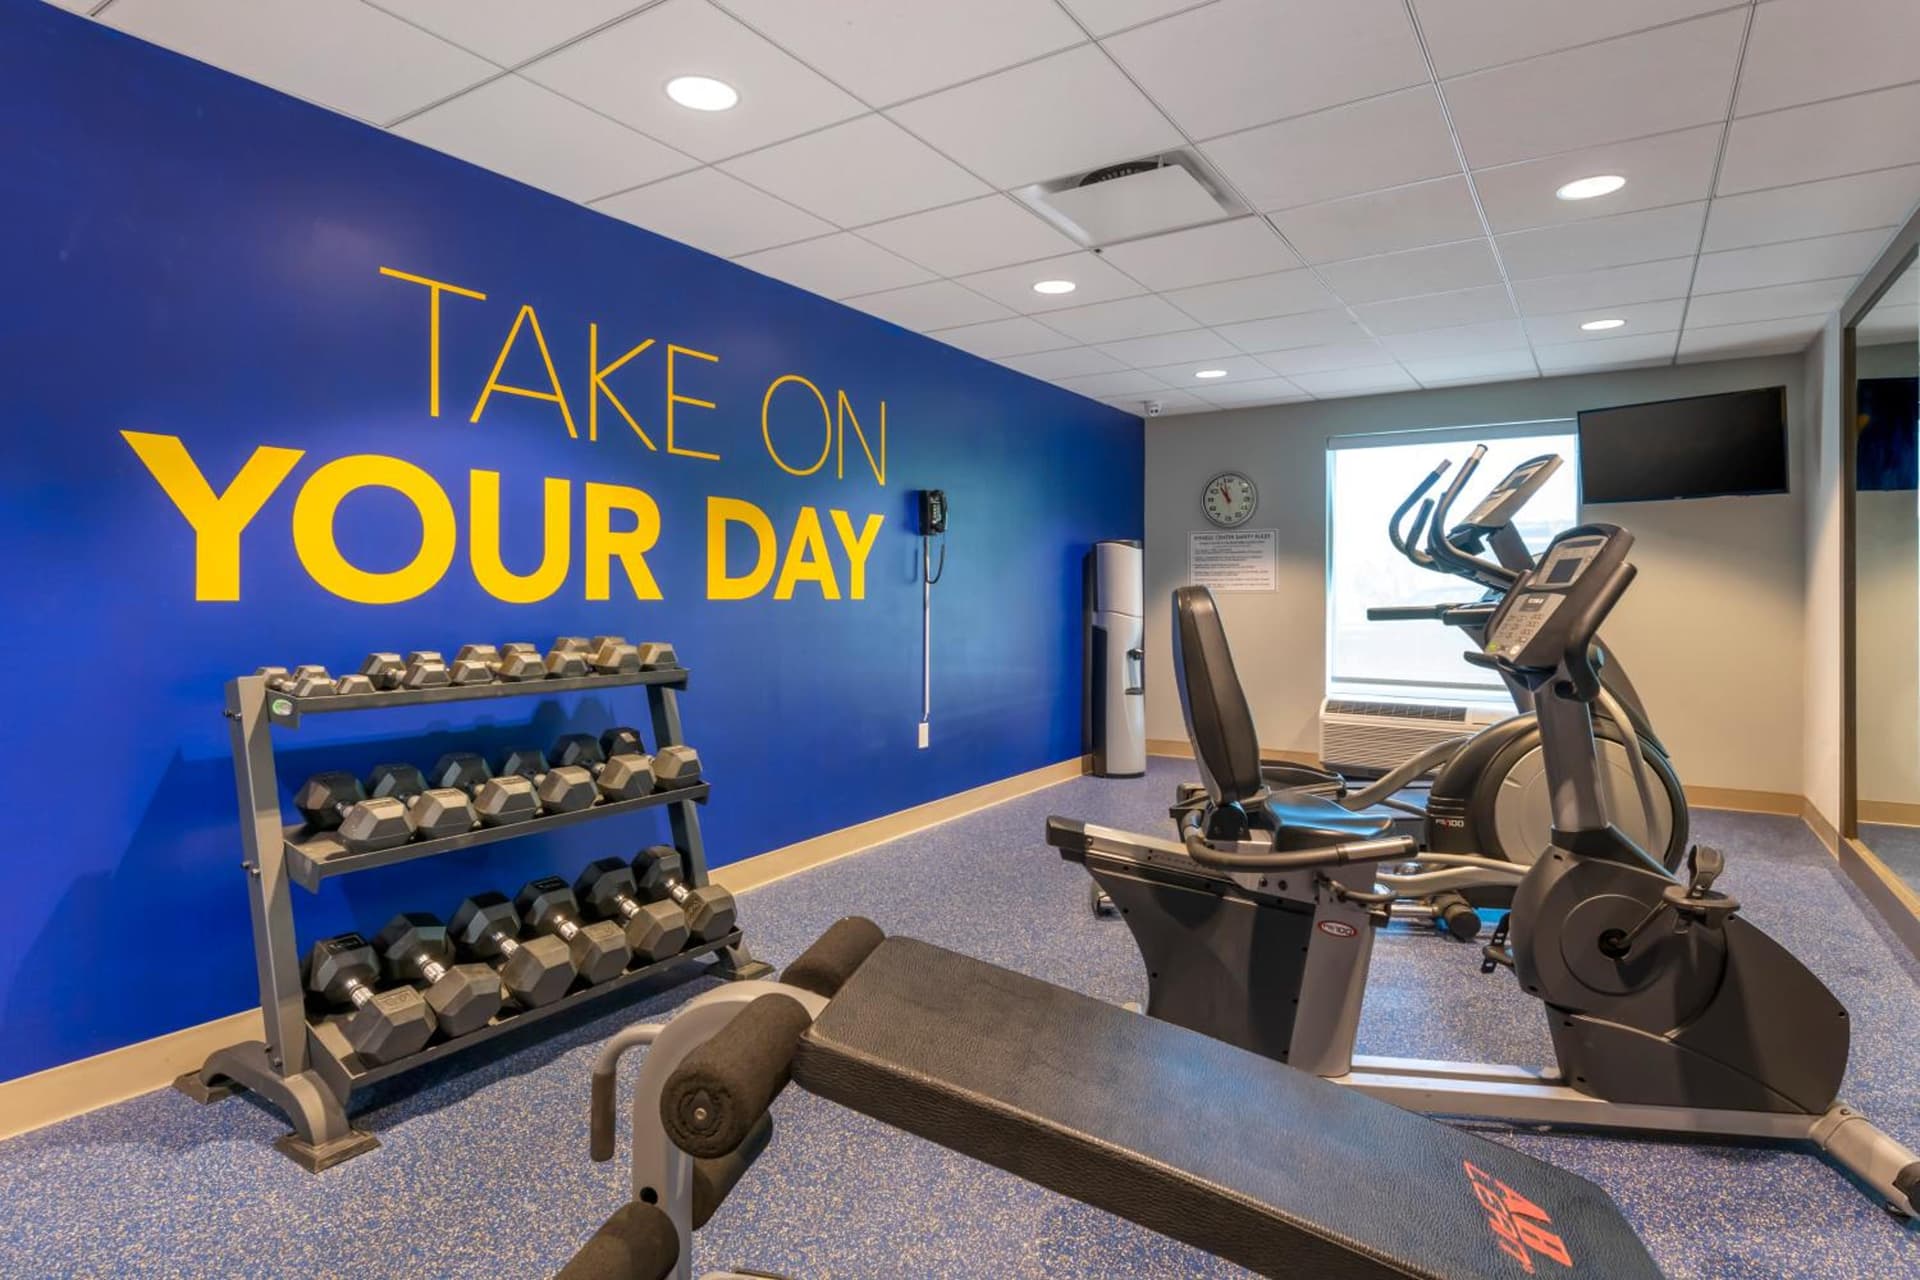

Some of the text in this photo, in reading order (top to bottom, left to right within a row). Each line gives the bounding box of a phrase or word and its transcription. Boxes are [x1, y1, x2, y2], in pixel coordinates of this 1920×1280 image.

[379, 266, 887, 486] TAKE ON
[120, 430, 885, 604] YOUR DAY
